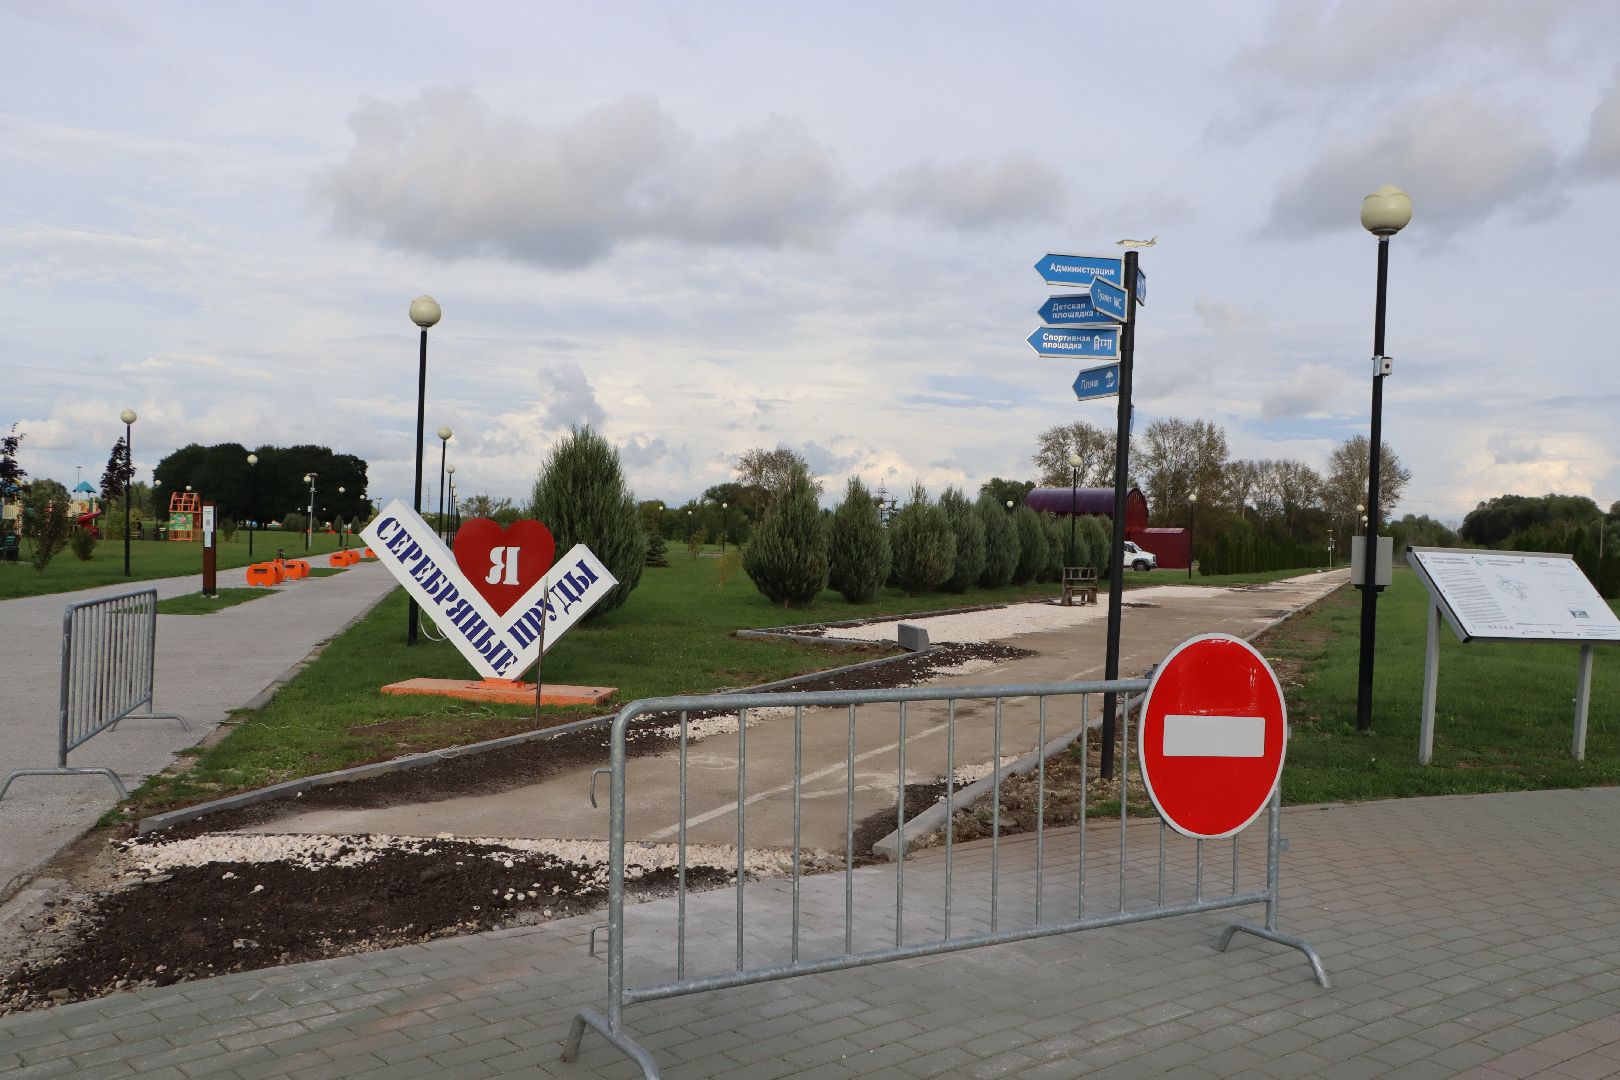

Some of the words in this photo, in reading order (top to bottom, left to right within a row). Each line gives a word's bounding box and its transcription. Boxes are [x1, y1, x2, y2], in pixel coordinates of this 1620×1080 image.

[1050, 262, 1115, 276] Администрация
[1052, 302, 1086, 311] Детская
[1052, 311, 1094, 319] площадка
[1043, 333, 1091, 343] Спортивная
[1043, 342, 1082, 350] площадка
[1080, 379, 1099, 390] Пляж
[485, 546, 520, 585] Я
[377, 517, 519, 676] СЕРЕБРЯНЫЕ
[507, 559, 599, 650] ПРУДЫ
